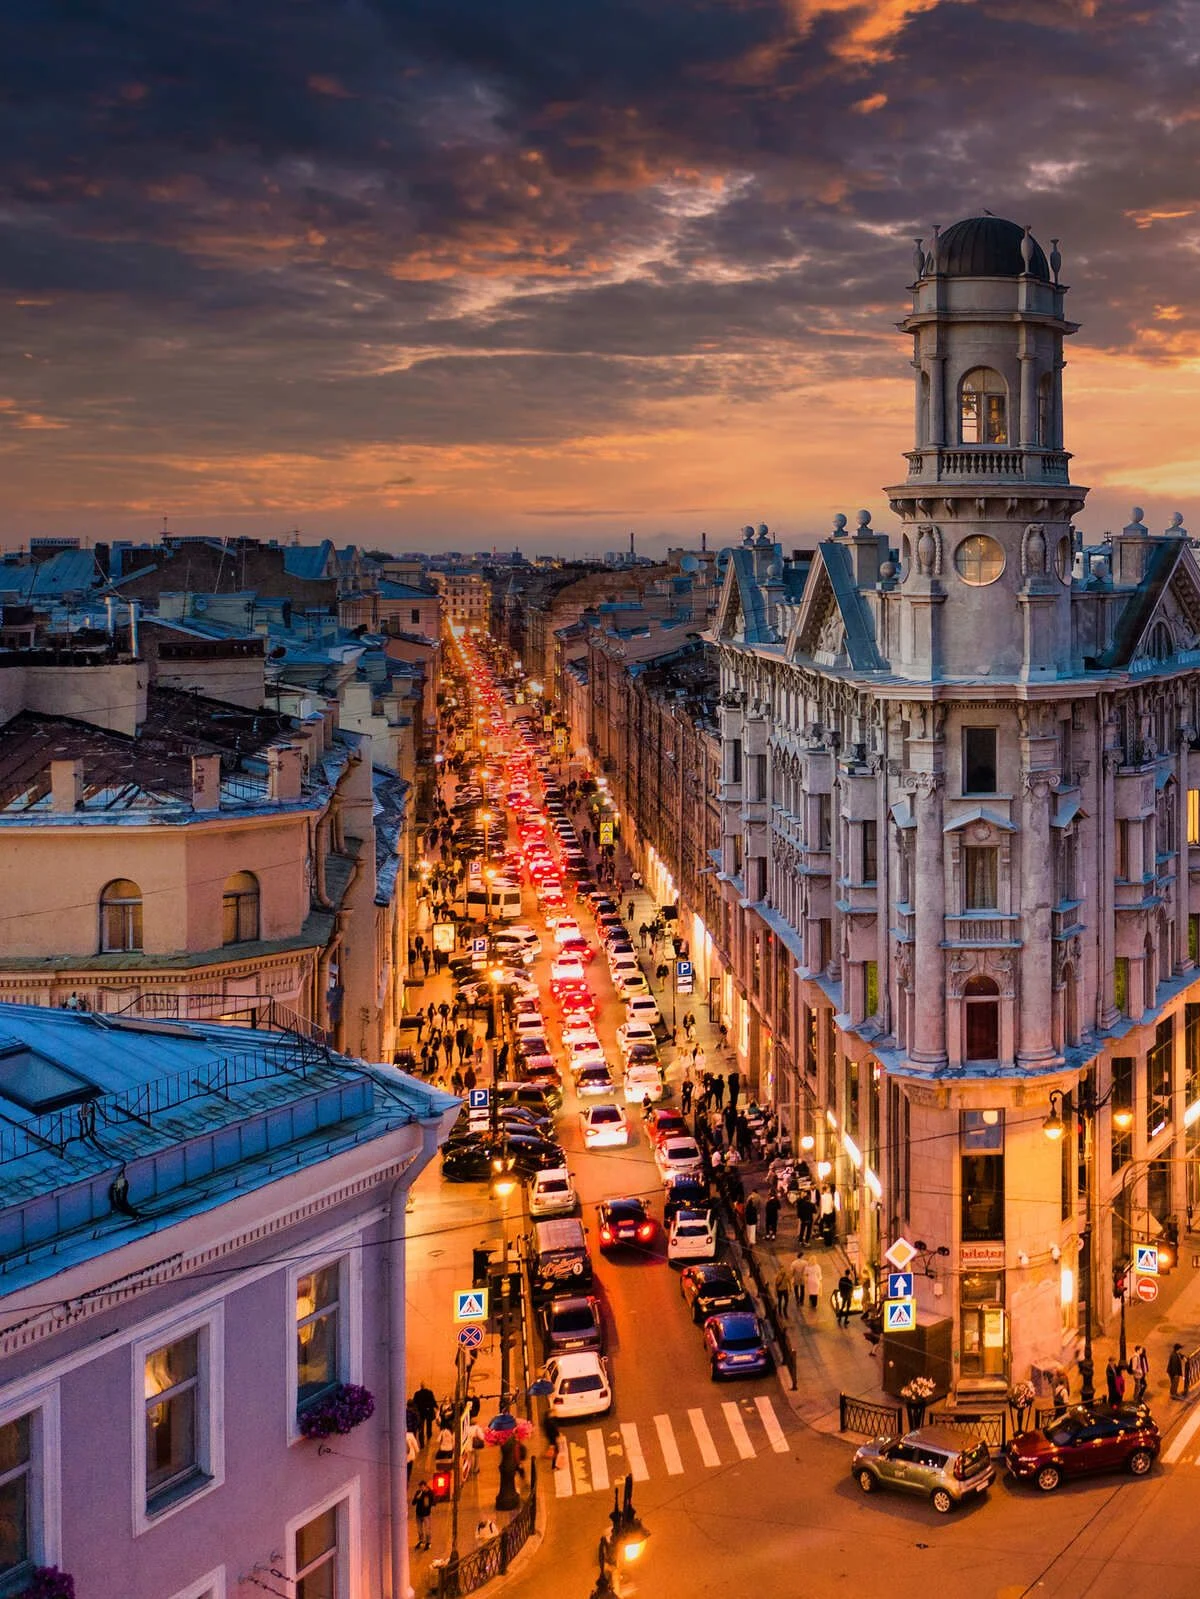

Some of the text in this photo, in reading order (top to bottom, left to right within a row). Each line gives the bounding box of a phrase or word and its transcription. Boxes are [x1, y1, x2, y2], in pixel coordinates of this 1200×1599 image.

[475, 940, 485, 951] P
[681, 962, 690, 974] P
[474, 1091, 485, 1106] P
